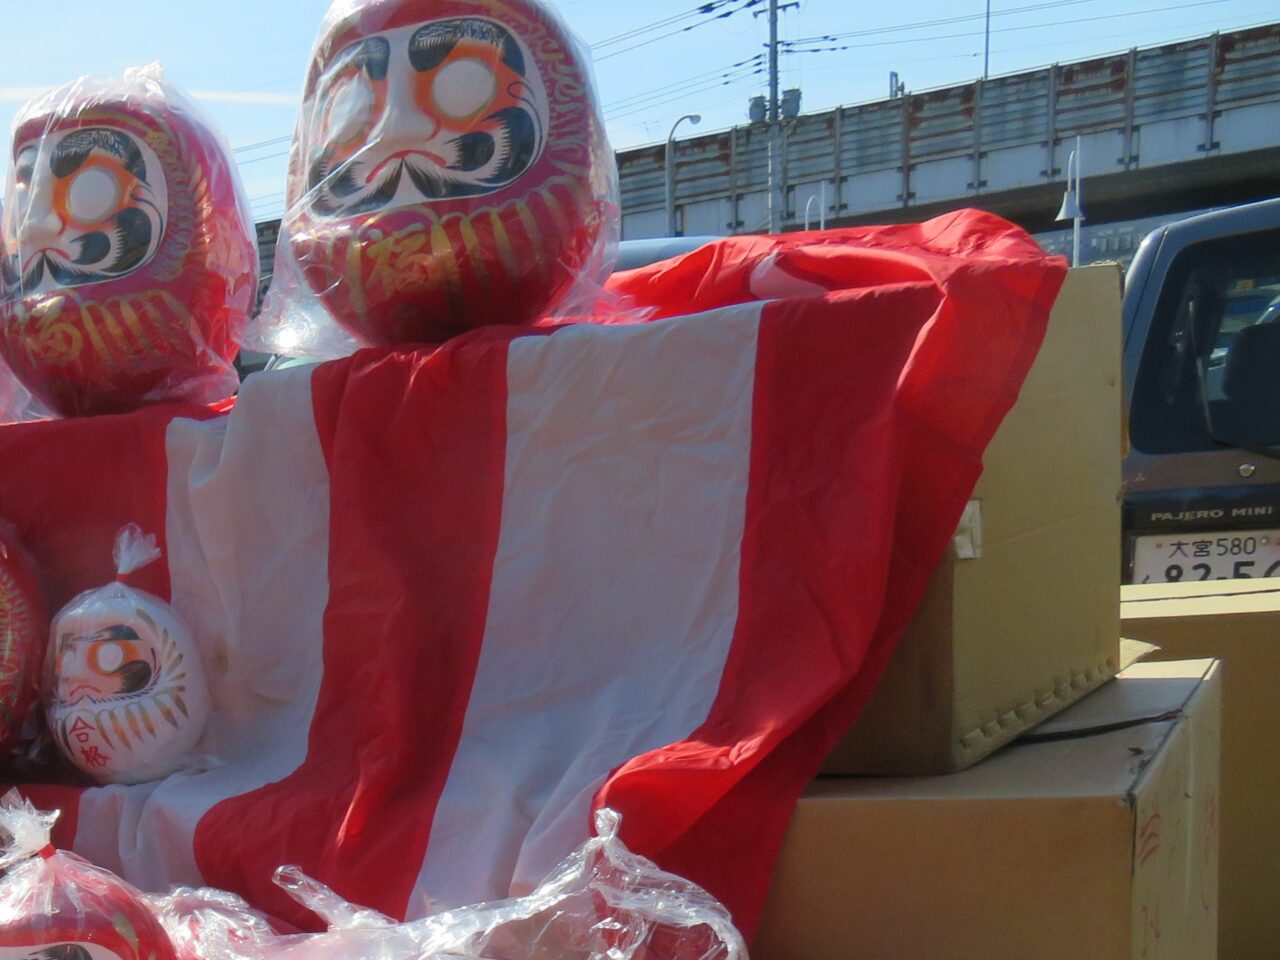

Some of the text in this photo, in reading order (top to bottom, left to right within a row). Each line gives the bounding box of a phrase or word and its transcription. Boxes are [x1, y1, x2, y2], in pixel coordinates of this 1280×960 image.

[1150, 506, 1273, 522] PAJERO MINI
[1168, 536, 1257, 559] 大宮580
